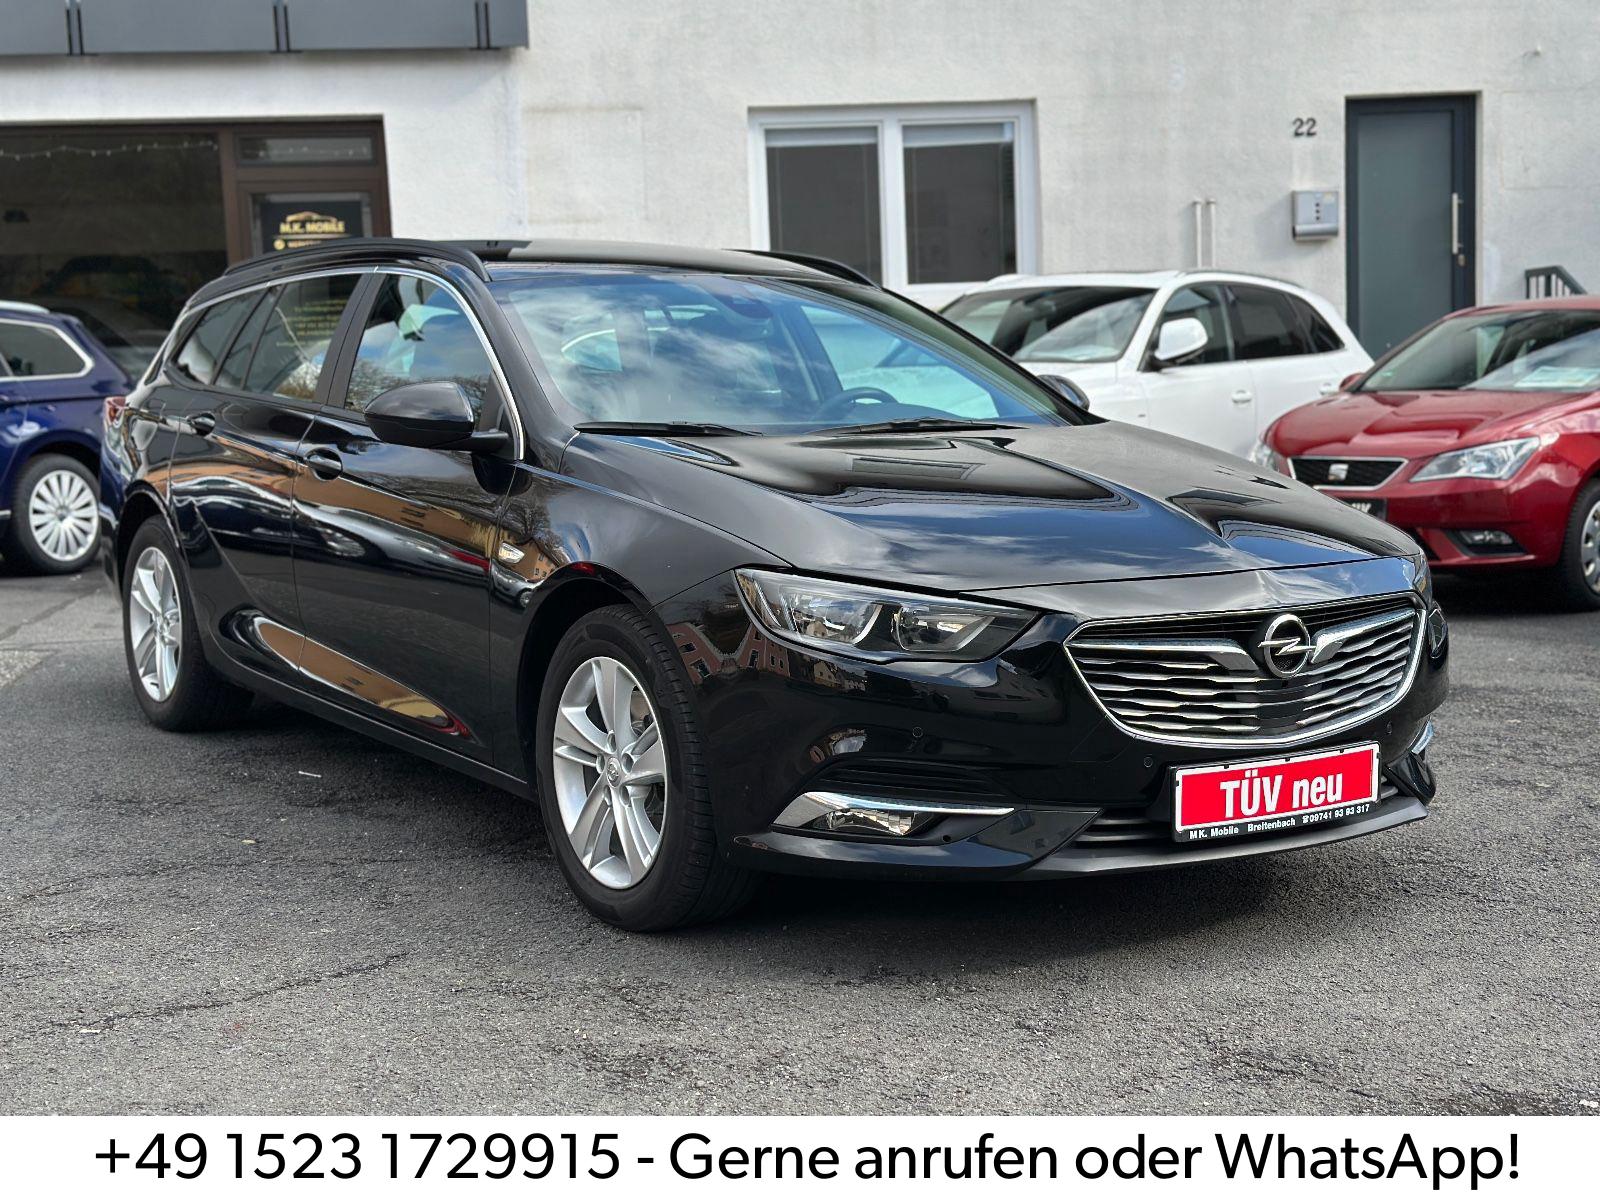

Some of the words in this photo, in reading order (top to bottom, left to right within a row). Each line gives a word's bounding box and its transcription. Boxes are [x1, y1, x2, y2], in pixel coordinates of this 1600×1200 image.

[1293, 118, 1317, 136] 22
[305, 221, 345, 233] MOBILE
[1220, 769, 1283, 818] TÜV
[1292, 773, 1343, 808] neu
[1211, 825, 1239, 837] Mobile
[1248, 817, 1296, 832] Breitenbach
[1356, 803, 1370, 814] 317
